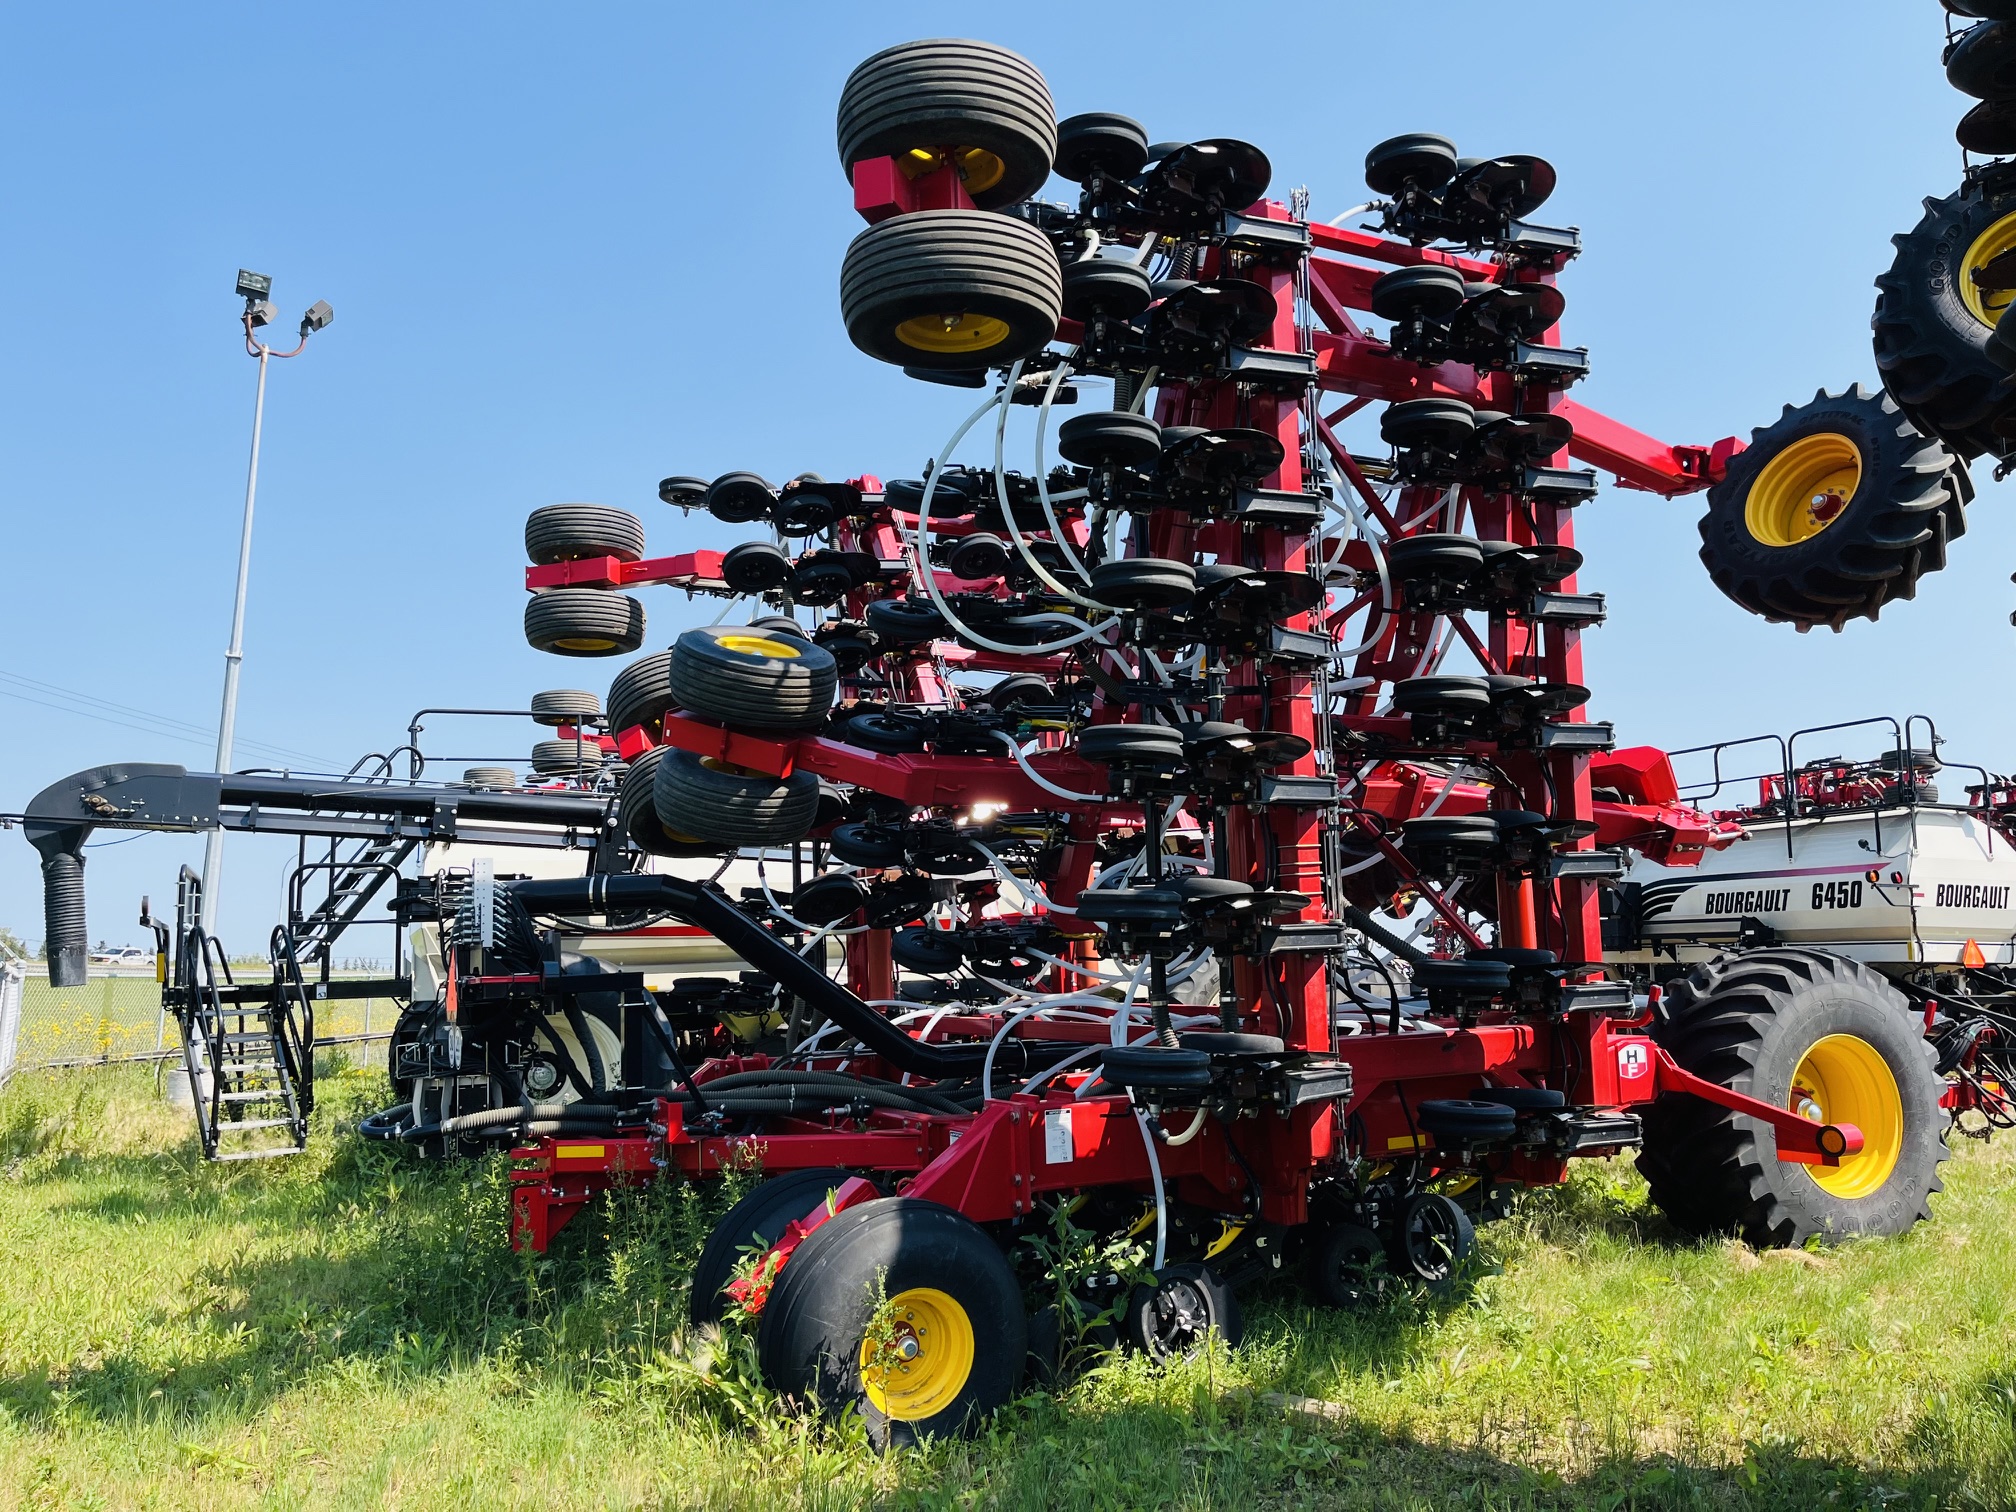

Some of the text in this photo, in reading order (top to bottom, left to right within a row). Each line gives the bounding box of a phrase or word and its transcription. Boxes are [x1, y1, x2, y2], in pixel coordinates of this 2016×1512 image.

[1705, 880, 1863, 915] BOURGAULT 6450
[1936, 883, 2011, 910] BOURGAULT
